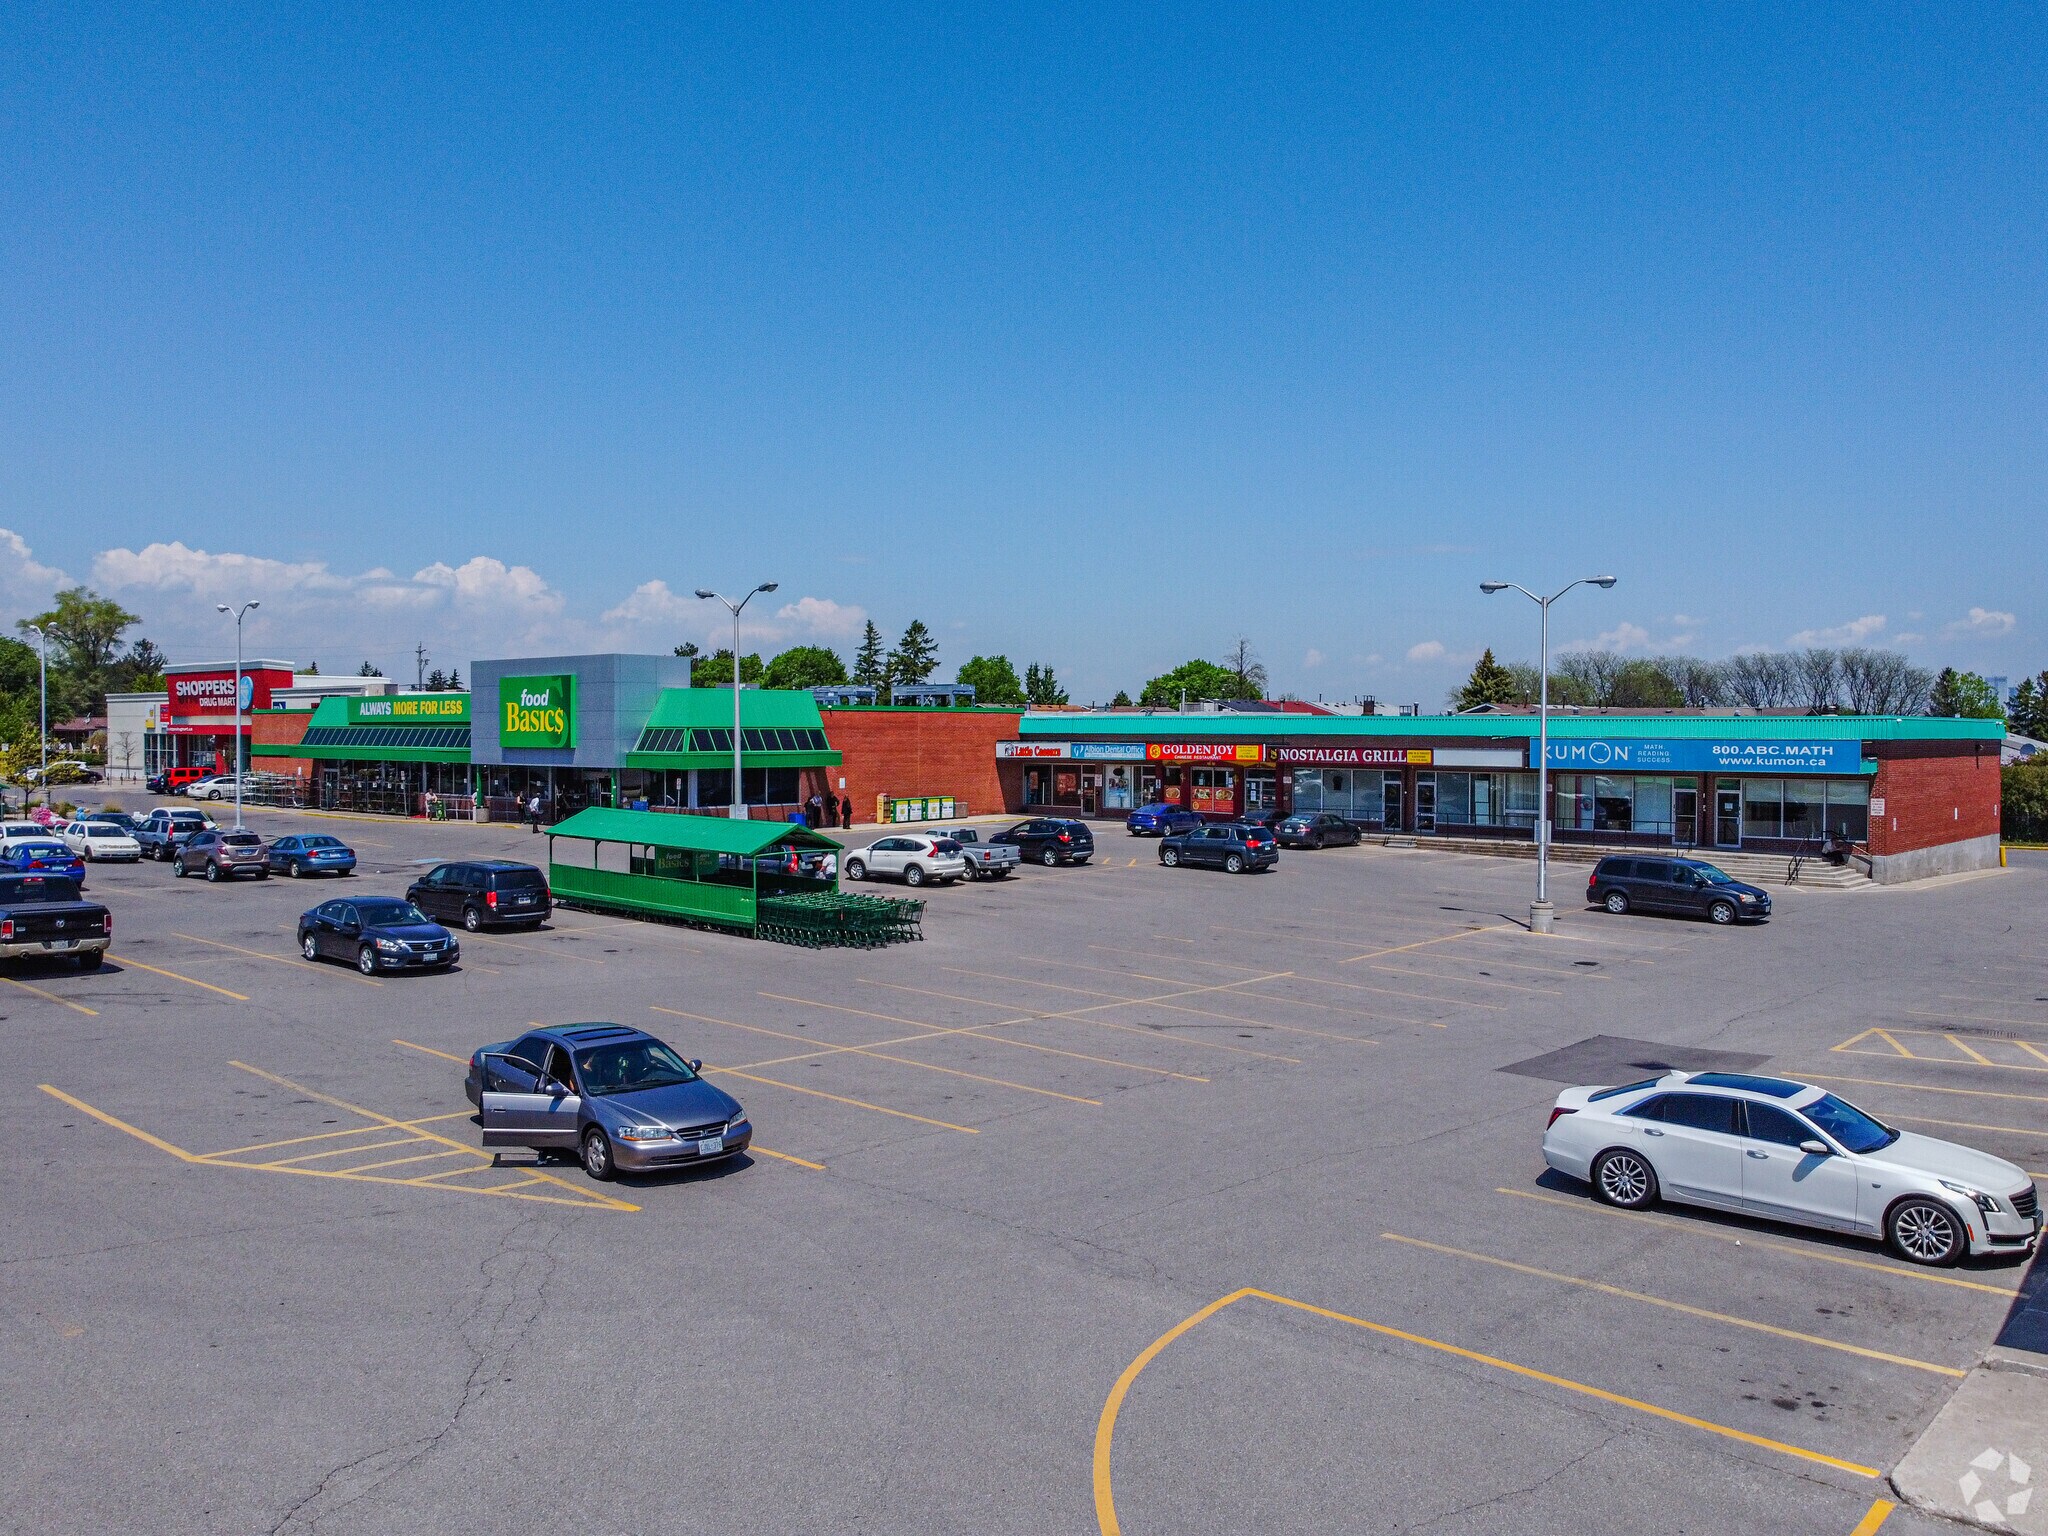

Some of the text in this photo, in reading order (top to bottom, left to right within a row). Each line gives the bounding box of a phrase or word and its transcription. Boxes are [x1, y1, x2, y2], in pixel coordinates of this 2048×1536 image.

[176, 679, 235, 696] SHOPPERS
[199, 697, 236, 707] DRUG MART
[521, 688, 549, 706] food
[360, 700, 463, 715] ALWAYS MORE FOR LESS
[1084, 744, 1104, 754] Albion
[1105, 745, 1125, 755] Dental
[1162, 744, 1211, 755] GOLDEN
[1212, 744, 1234, 757] JOY
[1280, 748, 1359, 762] NOSTALGIA
[1362, 749, 1406, 763] GRILL
[1712, 745, 1834, 756] 800.ABC.MATH
[1719, 756, 1826, 766] www.kumon.ca
